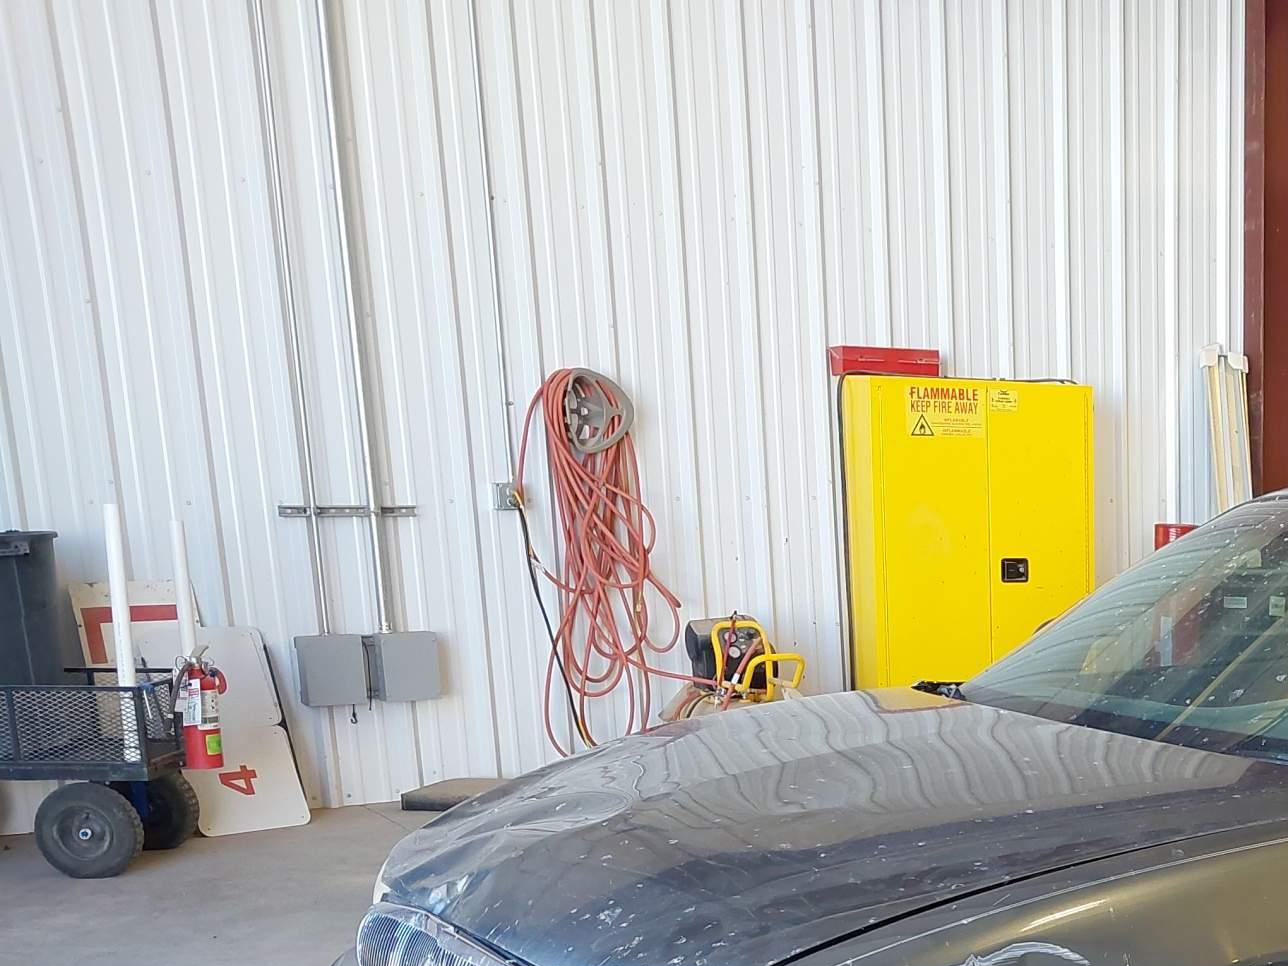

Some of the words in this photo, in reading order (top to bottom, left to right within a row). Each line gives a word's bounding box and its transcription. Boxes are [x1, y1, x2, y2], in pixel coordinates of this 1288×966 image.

[909, 386, 979, 401] FLAMMABLE
[910, 400, 931, 413] KEEP
[934, 401, 953, 415] FIRE
[955, 402, 979, 415] AWAY
[218, 764, 258, 796] 4
